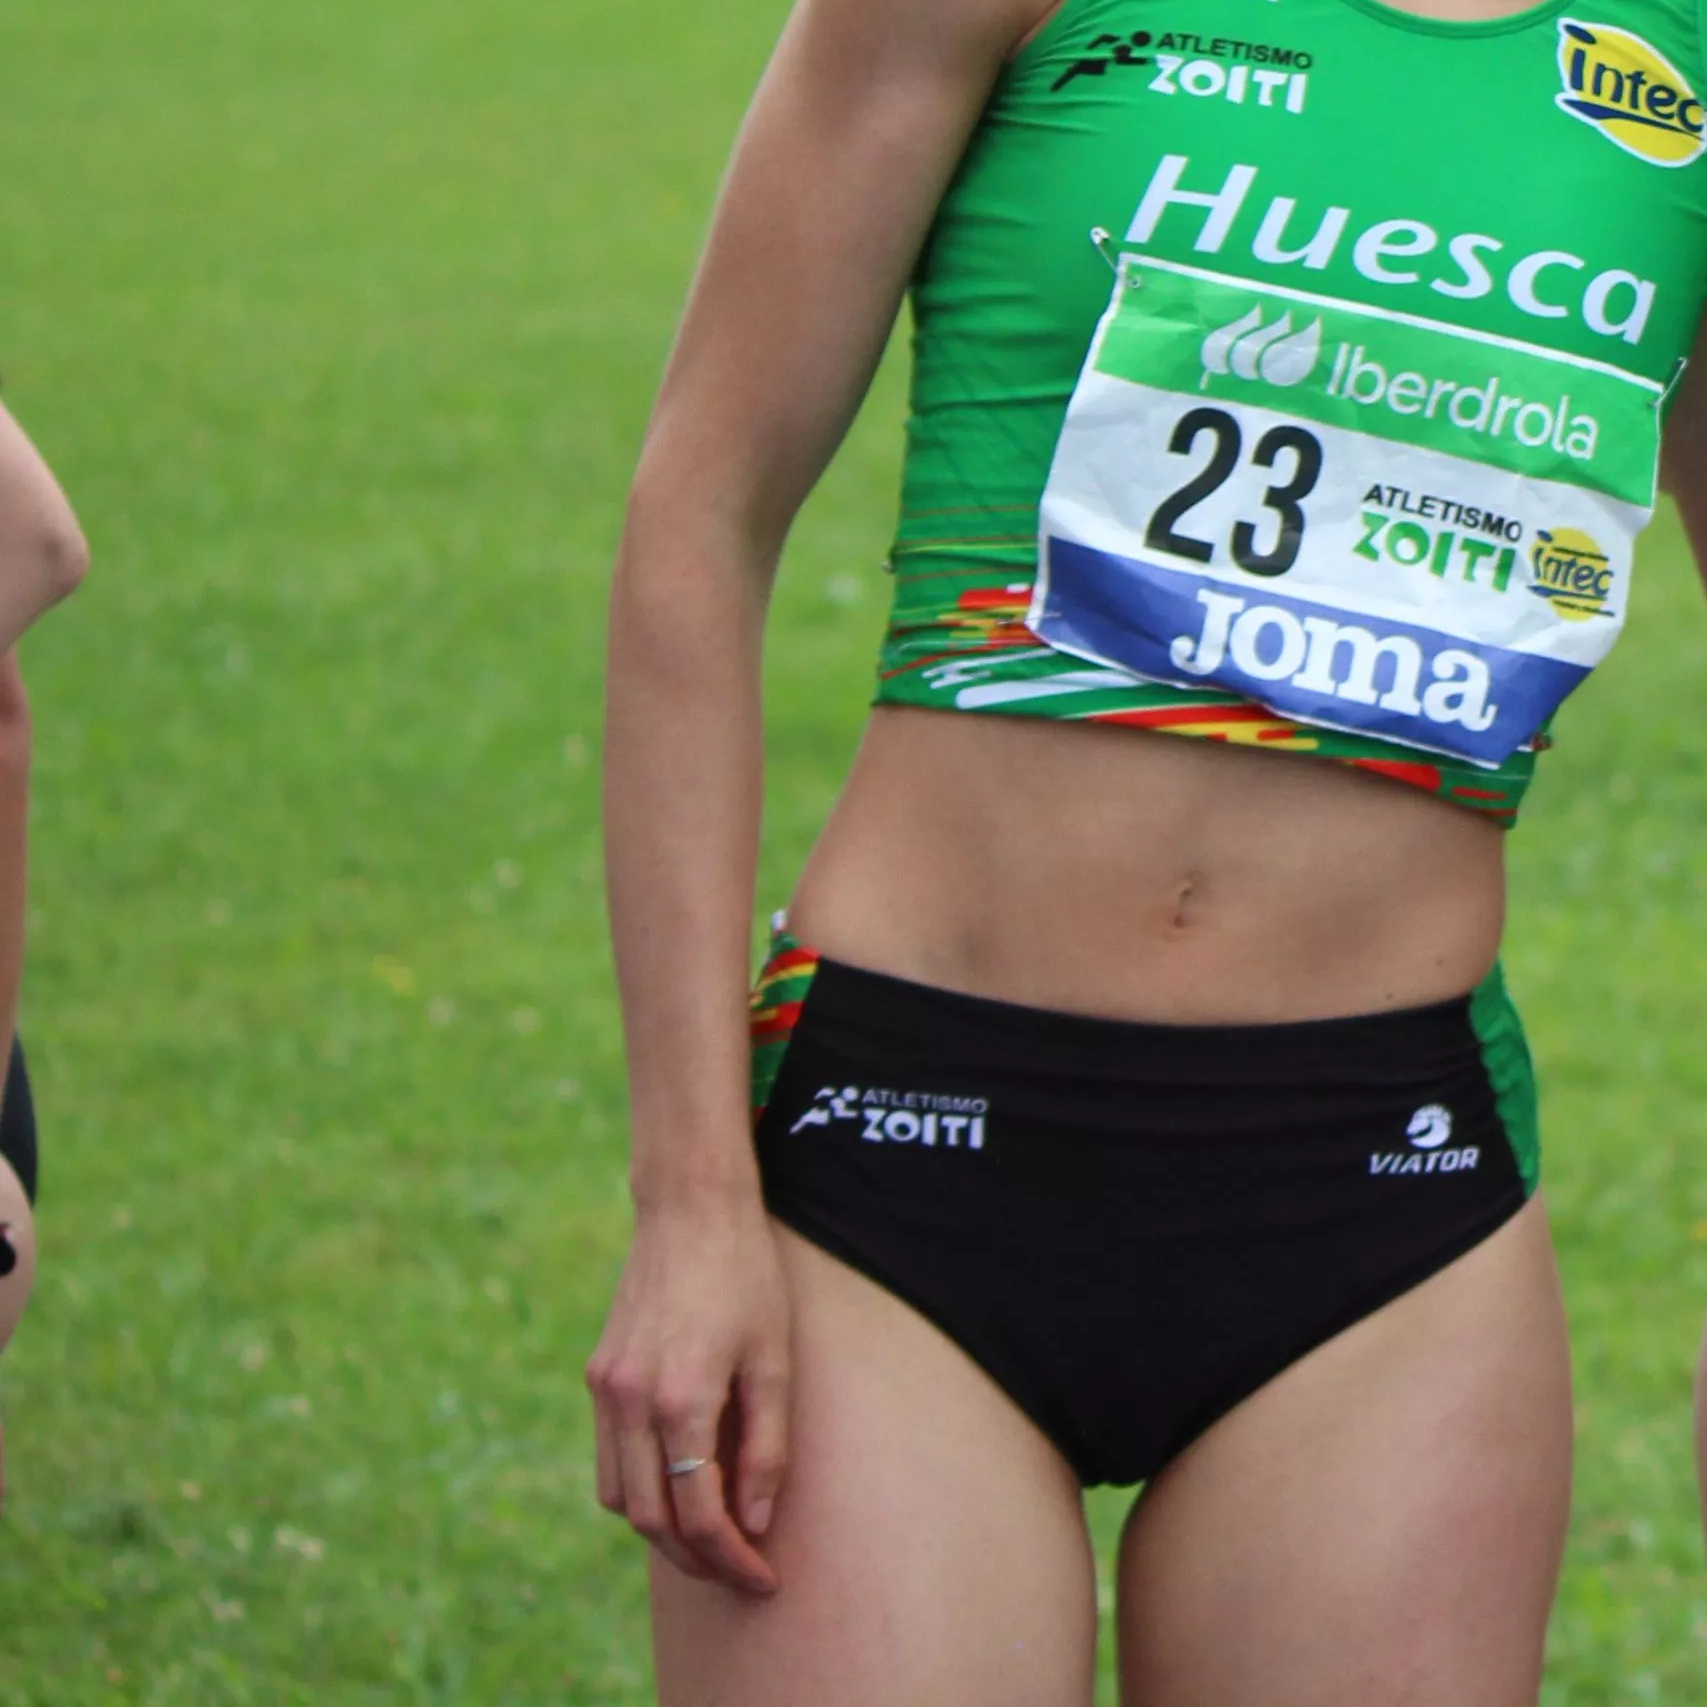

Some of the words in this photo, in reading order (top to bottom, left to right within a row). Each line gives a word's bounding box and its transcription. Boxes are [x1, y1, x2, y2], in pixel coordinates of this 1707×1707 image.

[1157, 32, 1313, 70] ATLETISMO
[1563, 22, 1707, 134] intec
[1148, 53, 1308, 114] ZOITI
[1125, 154, 1658, 345] Huesca
[1327, 343, 1598, 461] Iberdrola
[1143, 407, 1323, 577] 23
[1363, 483, 1523, 542] ATLETISMO
[1350, 511, 1516, 591] ZOITI
[1532, 529, 1614, 597] intec
[861, 1088, 989, 1114] ATLETISMO
[862, 1115, 987, 1149] ZOITI
[1369, 1146, 1480, 1175] VIATOR
